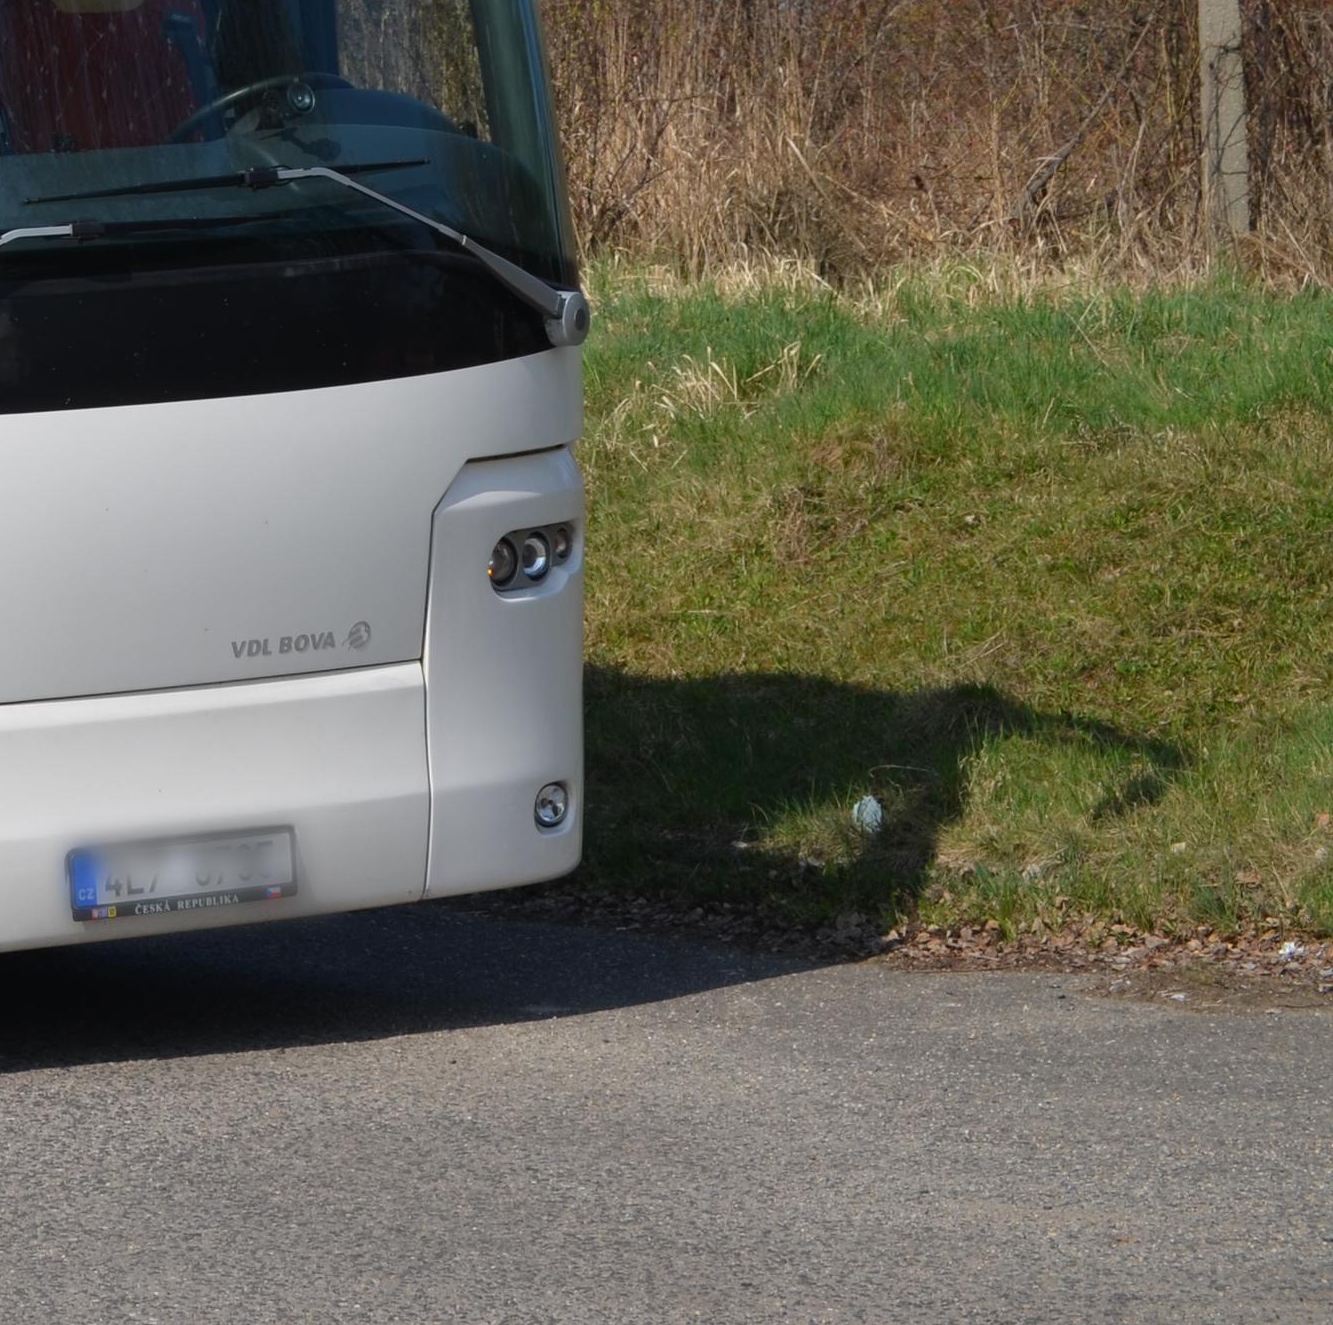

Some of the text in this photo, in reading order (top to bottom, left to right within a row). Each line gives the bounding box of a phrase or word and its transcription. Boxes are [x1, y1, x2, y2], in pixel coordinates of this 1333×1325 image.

[231, 631, 336, 658] VDL BOVA
[77, 888, 95, 901] CZ
[134, 893, 240, 916] ČESKÁ REPUBLIKA
